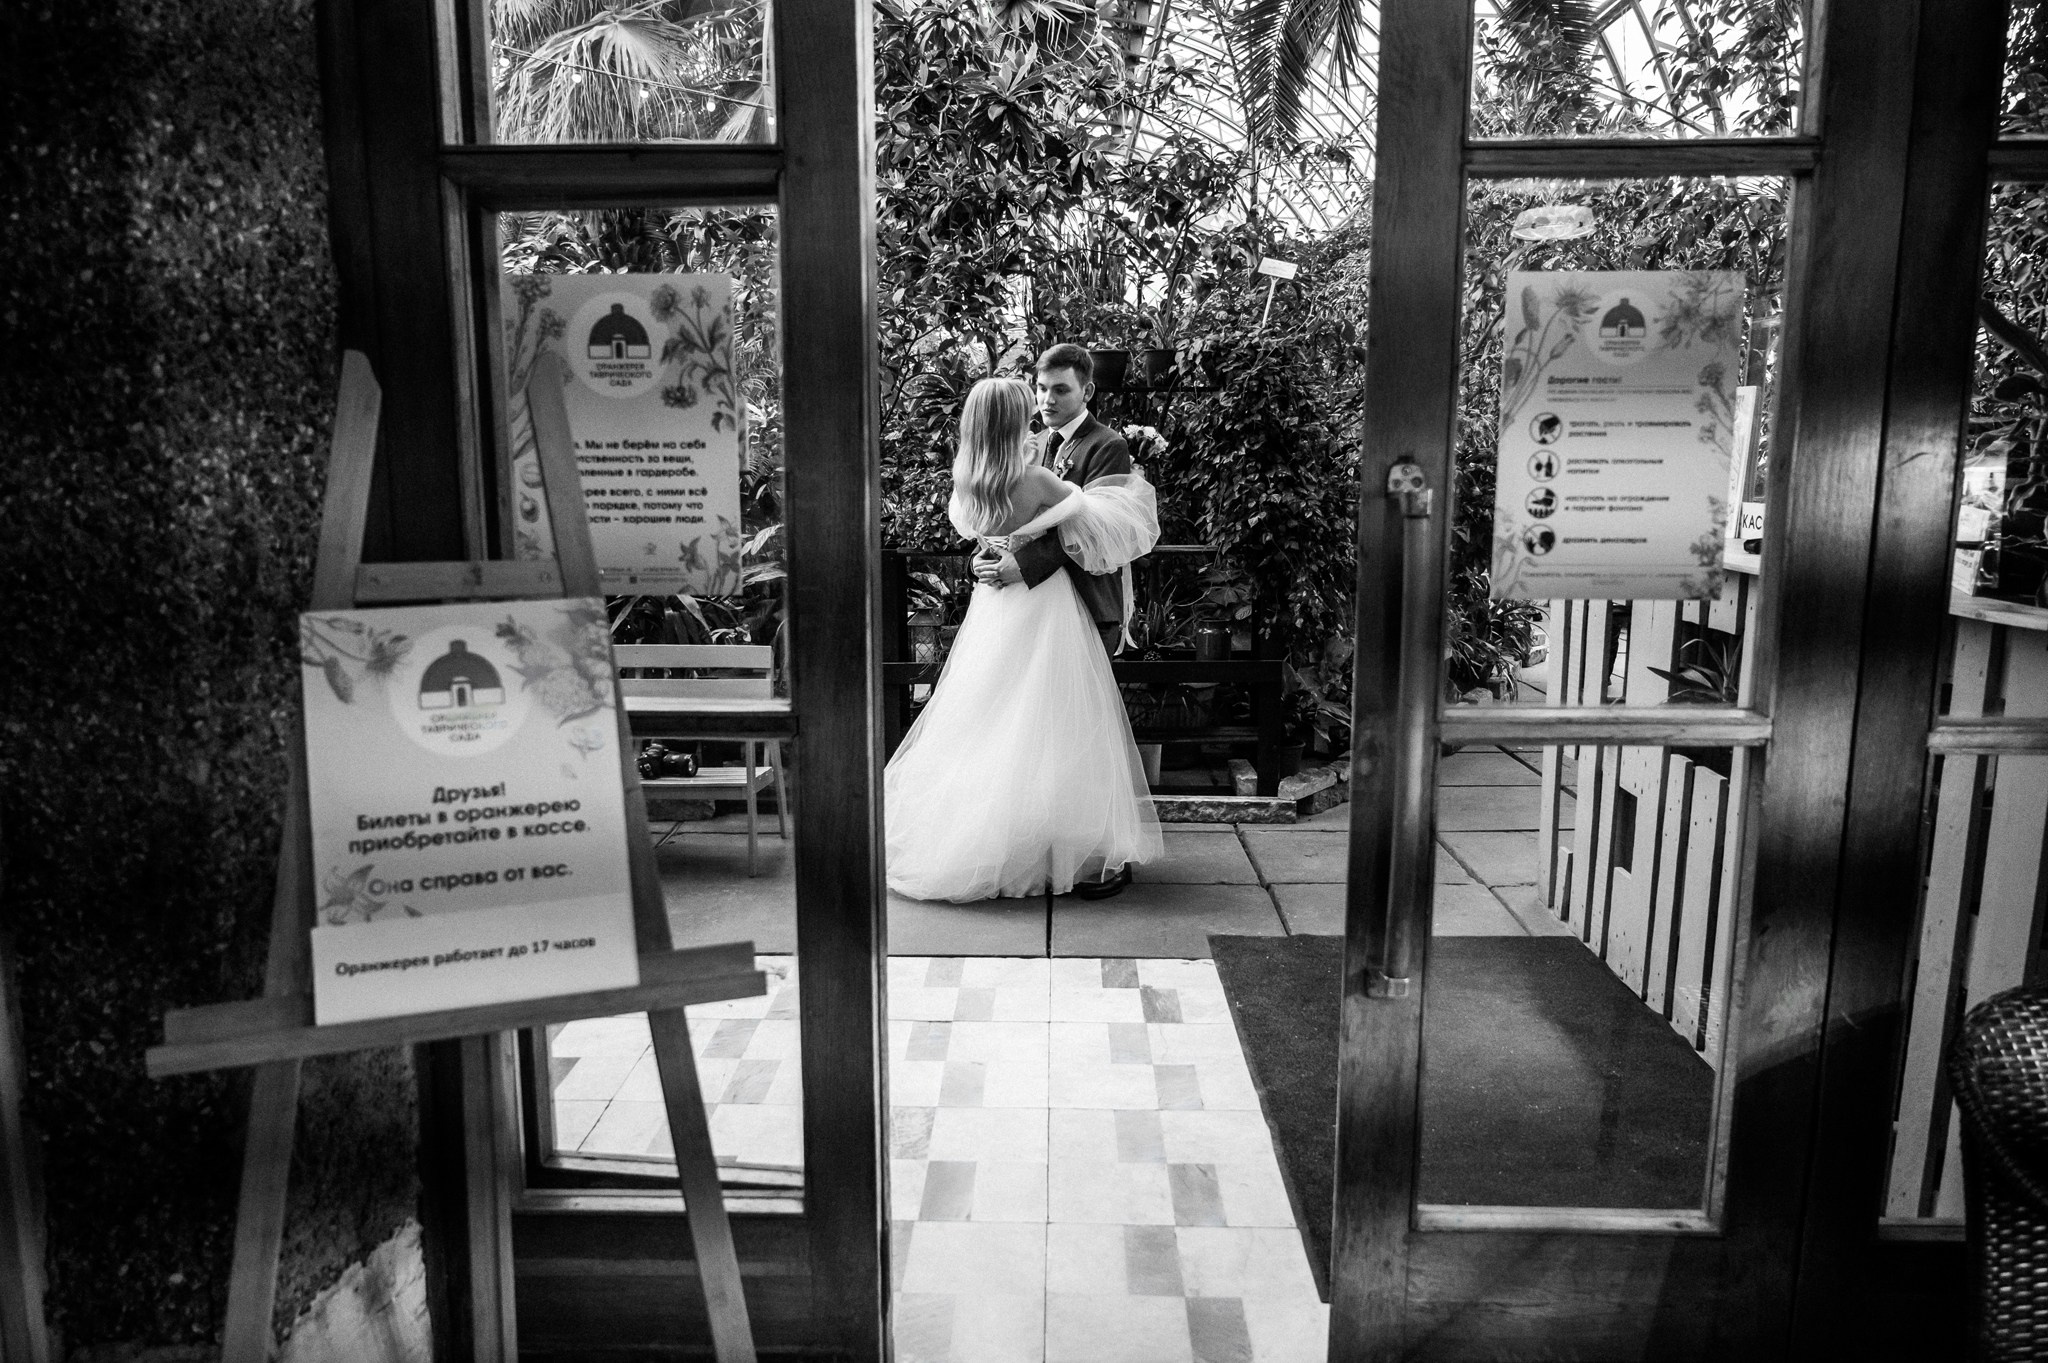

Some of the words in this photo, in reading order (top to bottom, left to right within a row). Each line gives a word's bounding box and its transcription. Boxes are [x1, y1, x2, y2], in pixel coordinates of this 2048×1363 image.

[1547, 375, 1589, 385] Дорогие
[584, 439, 604, 450] Мы
[605, 442, 620, 450] не
[622, 438, 660, 451] берём
[662, 441, 677, 450] на
[680, 438, 706, 450] себя
[576, 455, 644, 464] тственность
[647, 455, 660, 464] за
[663, 455, 695, 465] вещи,
[627, 469, 633, 477] в
[636, 466, 699, 479] гардеробе.
[610, 488, 644, 498] всего,
[646, 488, 653, 497] с
[656, 489, 686, 497] ними
[688, 486, 708, 497] всё
[592, 502, 641, 511] порядке,
[643, 502, 683, 511] потому
[685, 502, 704, 510] что
[623, 515, 672, 525] хорошие
[675, 515, 707, 525] люди.
[1742, 513, 1763, 530] КАС
[432, 781, 506, 805] Друзья!
[356, 812, 432, 832] Билеты
[437, 811, 448, 824] в
[454, 798, 581, 824] оранжерею
[348, 825, 501, 855] приобретайте
[506, 826, 517, 839] в
[523, 817, 591, 837] кассе.
[367, 877, 414, 895] Она
[419, 867, 499, 892] справа
[503, 867, 526, 882] от
[531, 861, 573, 879] вас.
[335, 954, 430, 977] Оранжерея
[433, 946, 504, 968] работает
[507, 944, 529, 958] до
[532, 939, 550, 954] 17
[553, 936, 597, 951] часов
